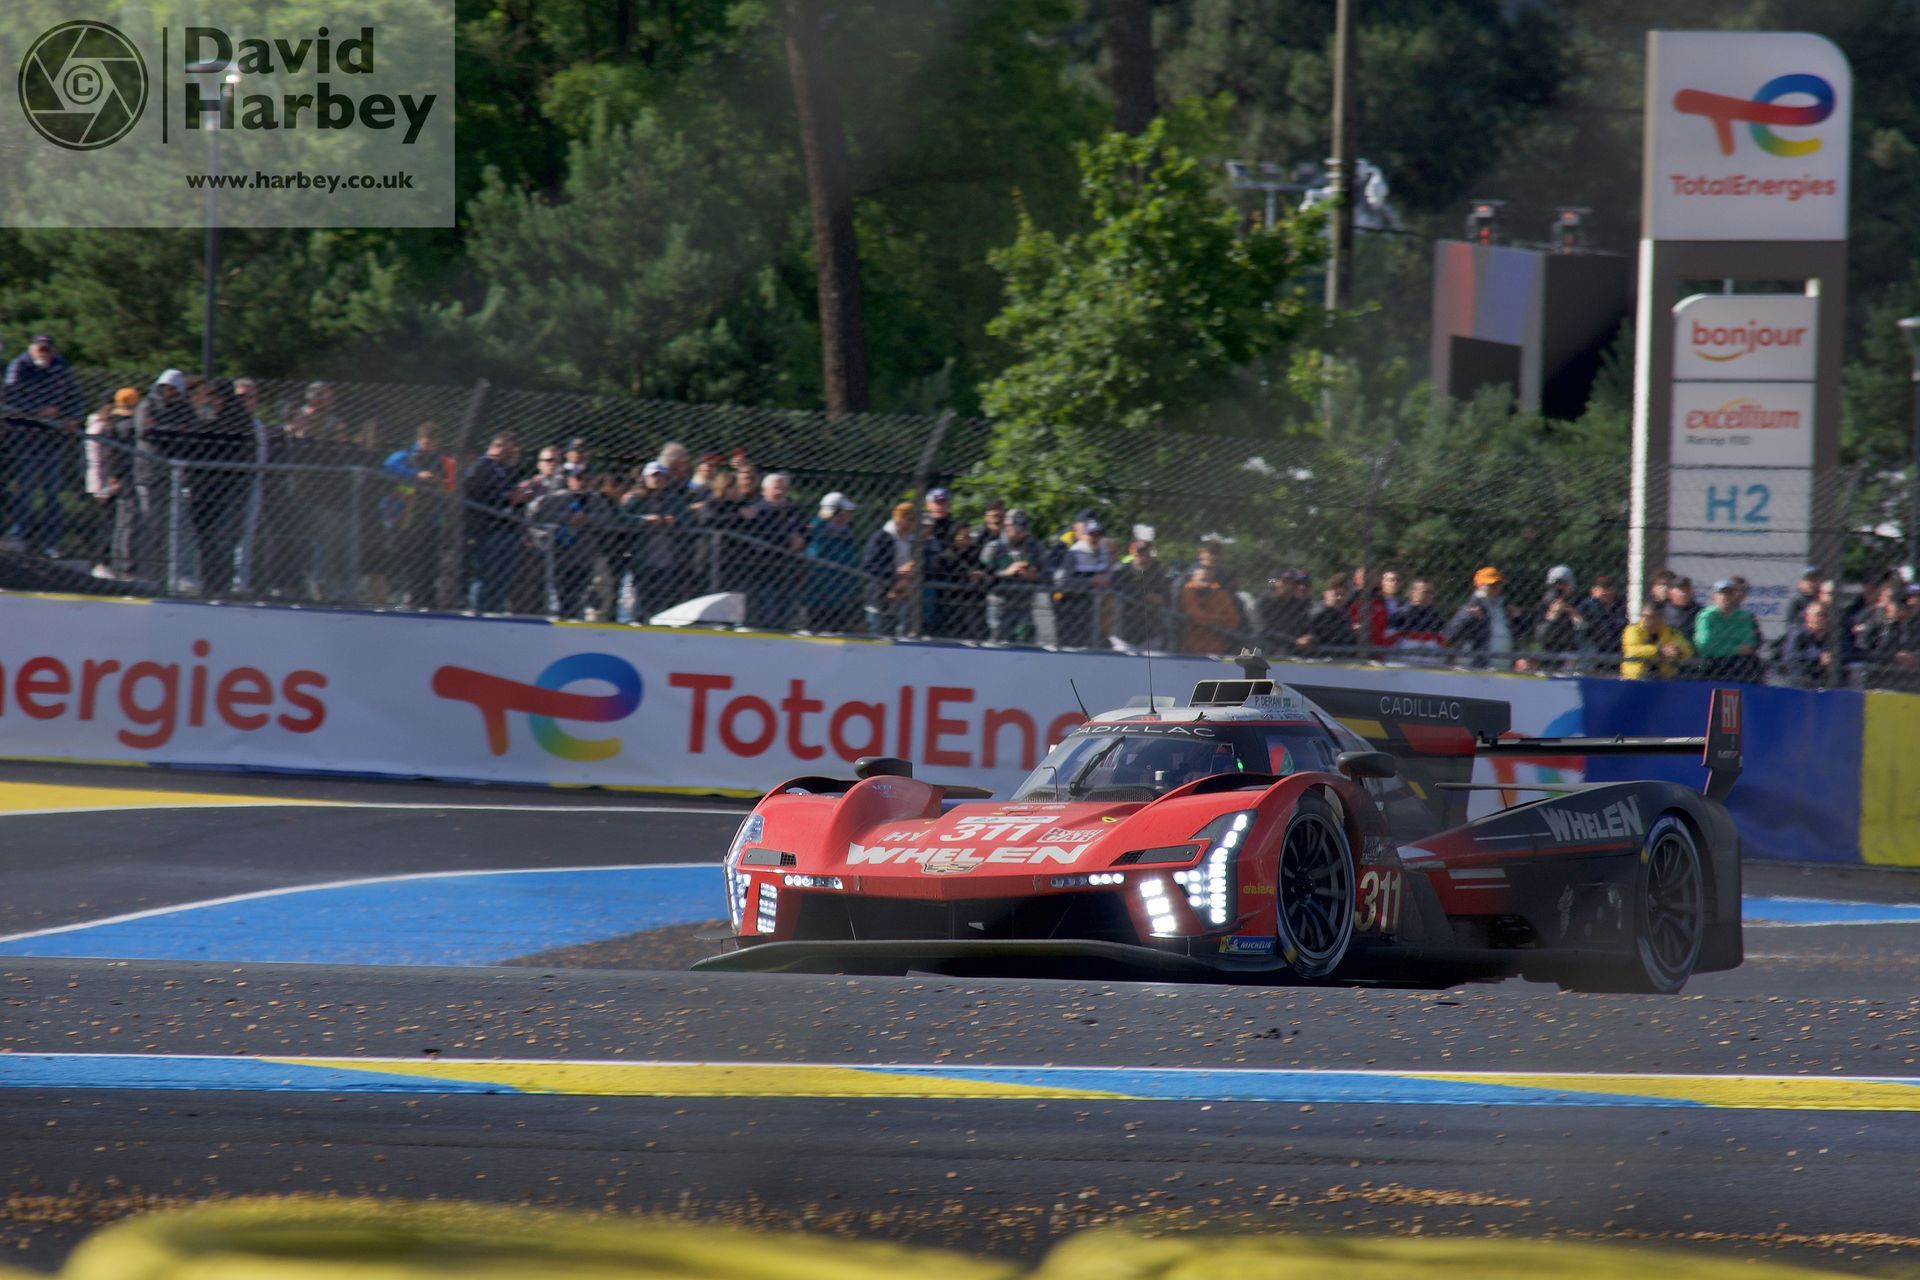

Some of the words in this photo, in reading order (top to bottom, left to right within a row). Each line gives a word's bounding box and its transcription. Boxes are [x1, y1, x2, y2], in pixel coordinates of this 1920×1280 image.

[1670, 174, 1836, 201] TotalEnergies
[1692, 320, 1808, 353] bonjour
[1706, 484, 1771, 523] H2
[0, 638, 328, 750] ergies
[1380, 696, 1460, 720] CADILLAC
[1722, 695, 1739, 728] HY
[939, 823, 1040, 841] 311
[1536, 795, 1644, 842] WHELEN
[846, 842, 1095, 865] WHELEN
[1355, 871, 1401, 932] 311
